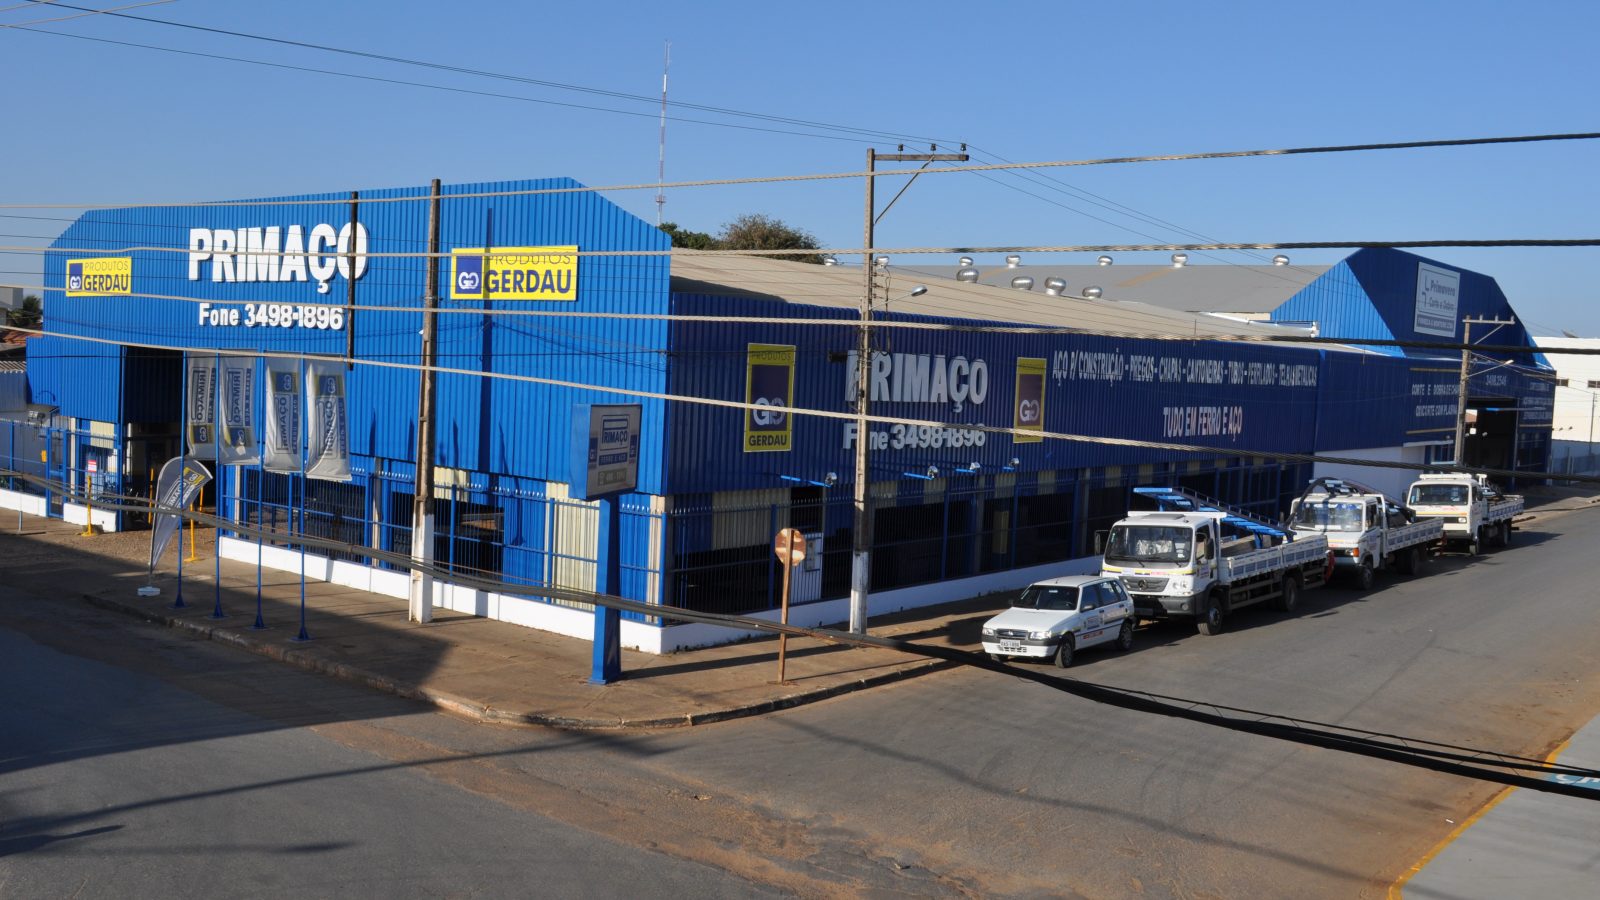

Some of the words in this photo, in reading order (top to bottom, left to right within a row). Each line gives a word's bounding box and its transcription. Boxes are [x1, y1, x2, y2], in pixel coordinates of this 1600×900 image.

[84, 261, 129, 271] PRODUTOS
[189, 222, 368, 294] PRIMAÇO
[84, 274, 129, 291] GERDAU
[484, 269, 572, 294] GERDAU
[199, 303, 240, 327] Fone
[245, 304, 345, 330] 3498-1896
[1052, 350, 1068, 386] AÇO
[1079, 347, 1123, 387] CONSTRUÇÃO
[842, 423, 888, 450] Fne
[1162, 406, 1184, 438] TUDO
[1185, 406, 1197, 437] EM
[1198, 406, 1221, 436] FERRO
[1222, 406, 1228, 435] E
[1228, 405, 1243, 443] AÇO
[748, 435, 788, 447] GERDAU
